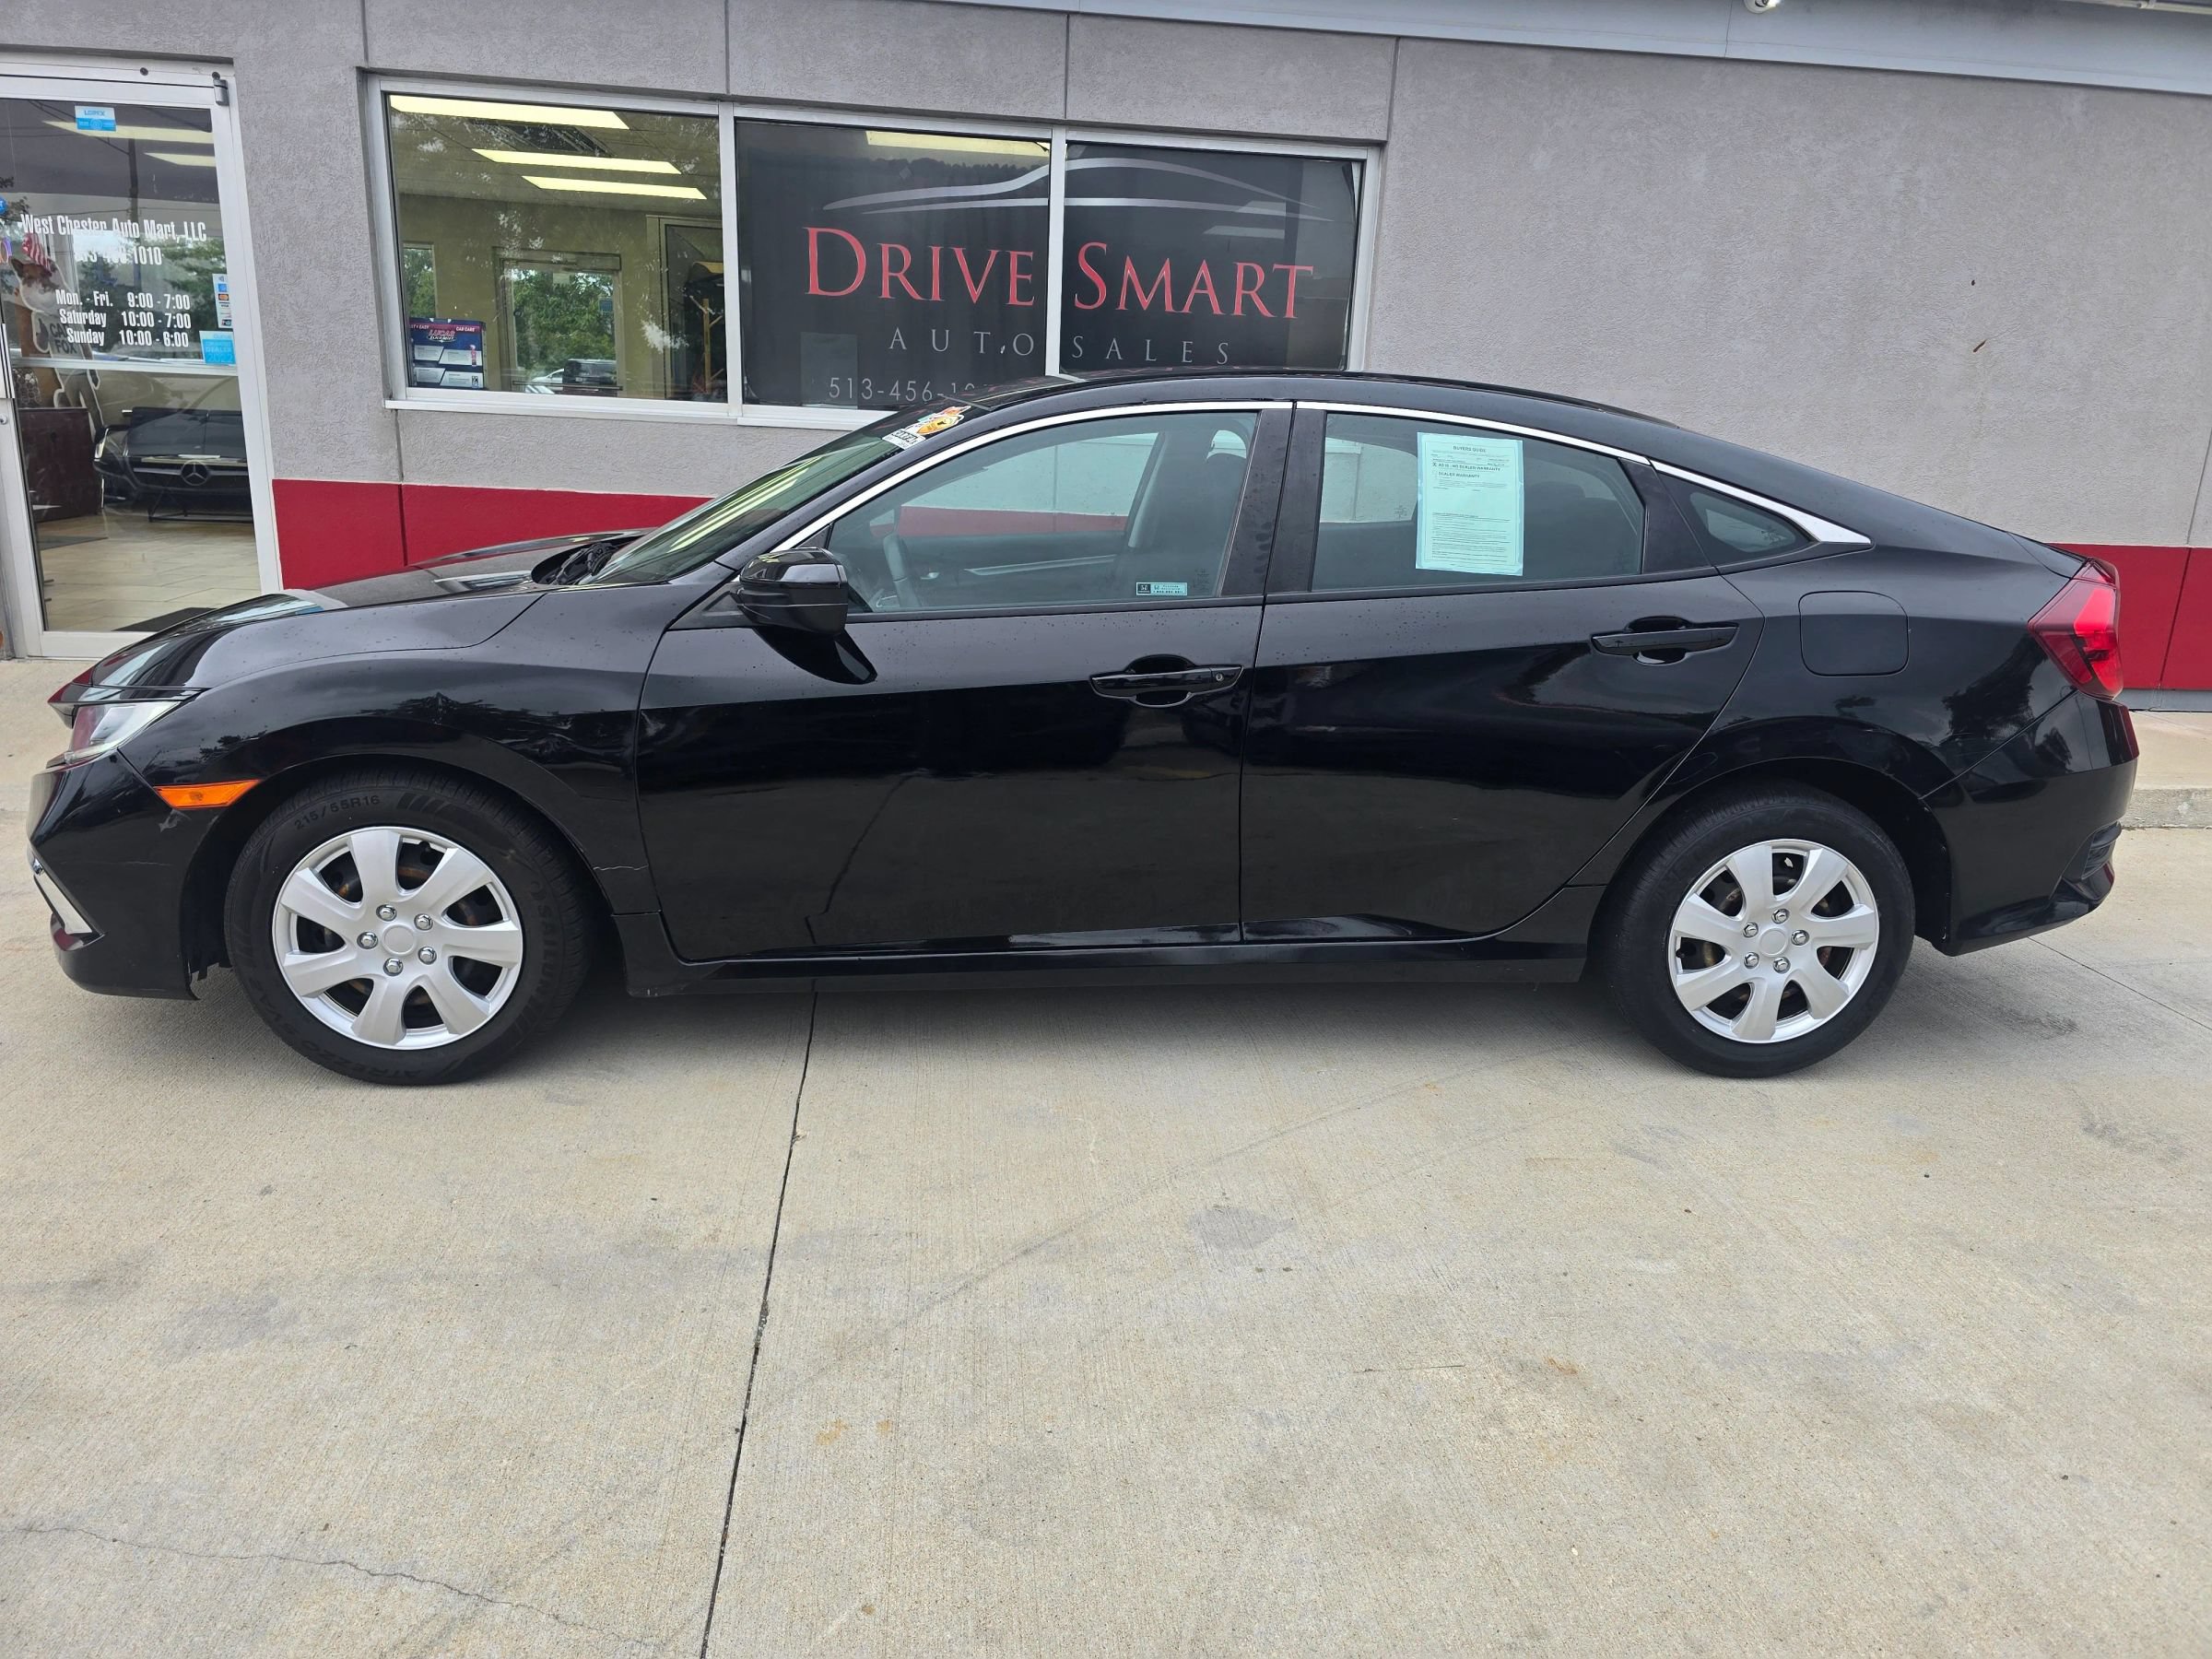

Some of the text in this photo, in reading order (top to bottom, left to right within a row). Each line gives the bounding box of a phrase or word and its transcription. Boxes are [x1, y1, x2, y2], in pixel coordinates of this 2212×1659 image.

[20, 213, 206, 243] West Chester Auto Mart, LLC
[803, 226, 1314, 320] DRIVE SMART
[56, 289, 83, 305] Mon.
[93, 290, 113, 307] Fri.
[127, 292, 154, 309] 9:00
[164, 294, 191, 310] 7:00
[59, 309, 107, 327] Saturday
[122, 311, 155, 327] 10:00
[164, 312, 192, 329] 7:00
[66, 328, 105, 347] Sunday
[119, 330, 153, 346] 10:00
[162, 332, 189, 347] 6:00
[888, 327, 1230, 365] AUTO SALES
[294, 794, 381, 830] 215/55R16
